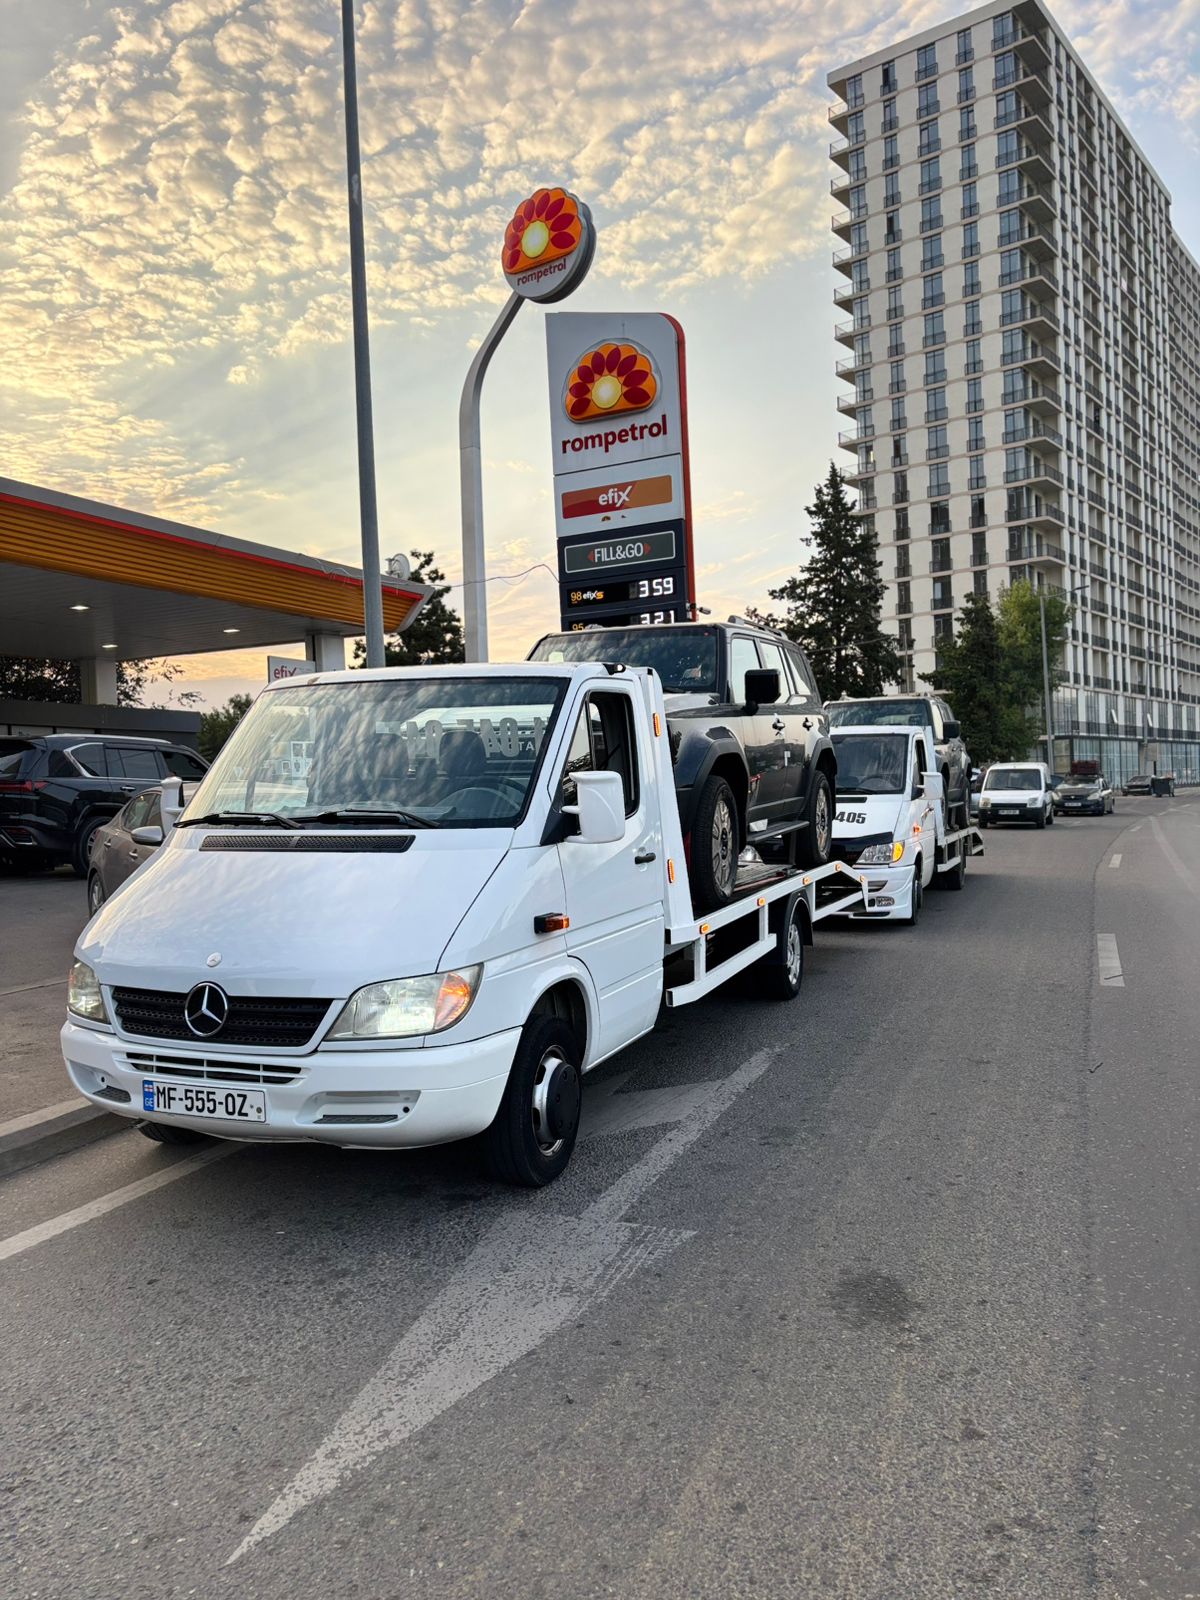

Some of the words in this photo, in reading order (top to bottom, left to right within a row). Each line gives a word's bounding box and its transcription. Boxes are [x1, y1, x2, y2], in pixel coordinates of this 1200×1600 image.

[516, 257, 567, 286] rompetrol
[561, 413, 668, 454] rompetrol
[598, 485, 633, 507] efix
[594, 542, 644, 563] FILL&GO
[570, 591, 583, 602] 98
[834, 811, 867, 825] 405
